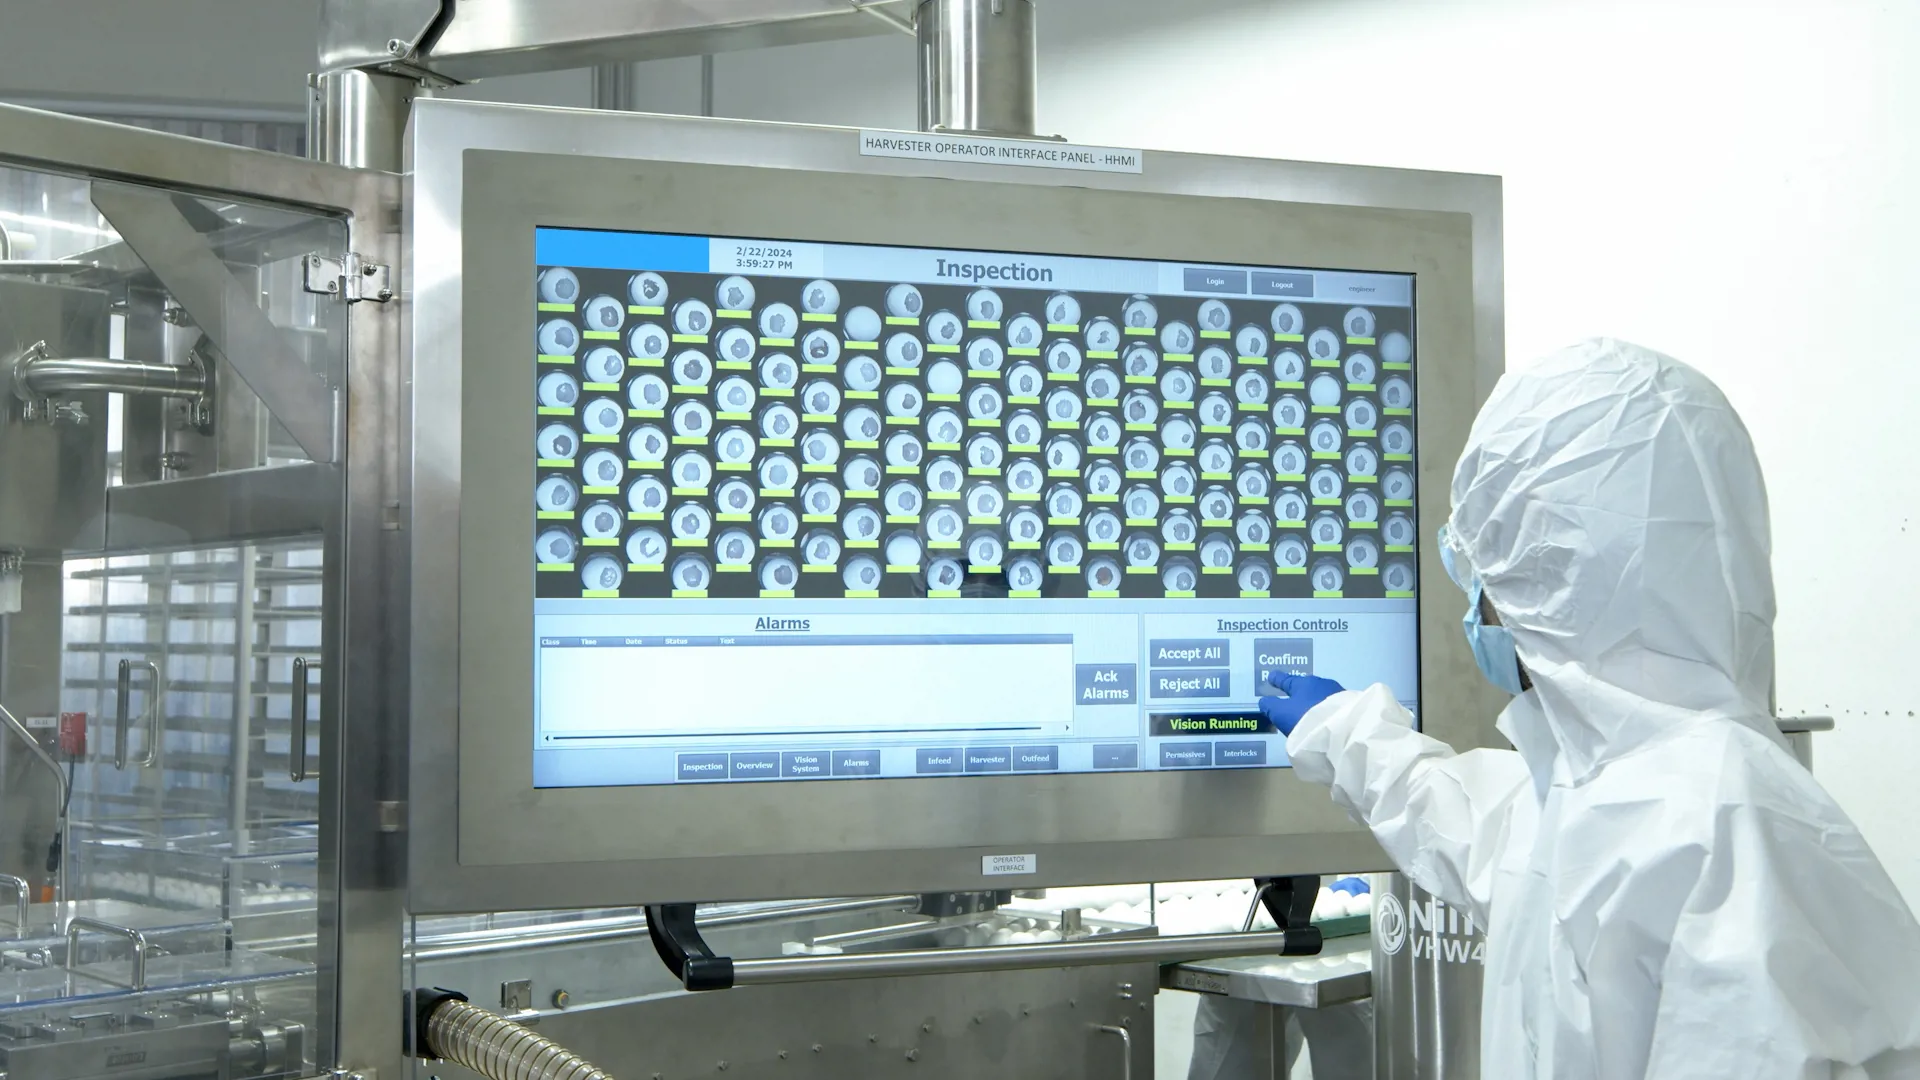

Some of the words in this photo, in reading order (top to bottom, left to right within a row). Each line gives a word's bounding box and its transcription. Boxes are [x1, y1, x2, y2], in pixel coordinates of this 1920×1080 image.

[866, 138, 931, 153] HARVESTER
[935, 143, 996, 157] OPERATOR
[999, 147, 1058, 161] INTERFACE
[1061, 152, 1096, 164] PANEL
[1105, 155, 1136, 166] HHMI
[736, 246, 793, 258] 2/22/2024
[736, 258, 775, 269] 3:59:27
[778, 260, 793, 270] PM
[936, 258, 1053, 282] Inspection
[1206, 277, 1225, 287] Login
[1271, 280, 1294, 290] Logout
[755, 616, 810, 630] Alarms
[1217, 618, 1289, 632] Inspection
[1293, 618, 1349, 631] Controls
[541, 638, 560, 646] Class
[625, 638, 643, 646] Date
[719, 637, 736, 645] Text
[1158, 647, 1201, 661] Accept
[1204, 646, 1221, 660] All
[1258, 653, 1308, 666] Confirm
[1094, 669, 1119, 683] Ack
[1159, 678, 1200, 693] Reject
[1204, 677, 1220, 690] All
[1083, 686, 1130, 699] Alarms
[1170, 717, 1206, 730] Vision
[1210, 717, 1258, 731] Running
[1021, 754, 1050, 763] Outfeed
[1165, 750, 1206, 760] Permissives
[1224, 749, 1258, 758] Interlocks
[794, 755, 818, 764] Vision
[843, 758, 870, 767] Alarms
[928, 756, 952, 766] Infeed
[970, 755, 1006, 764] Harvester
[682, 762, 723, 772] Inspection
[736, 761, 774, 770] Overview
[792, 764, 820, 774] System
[993, 856, 1025, 864] OPERATOR
